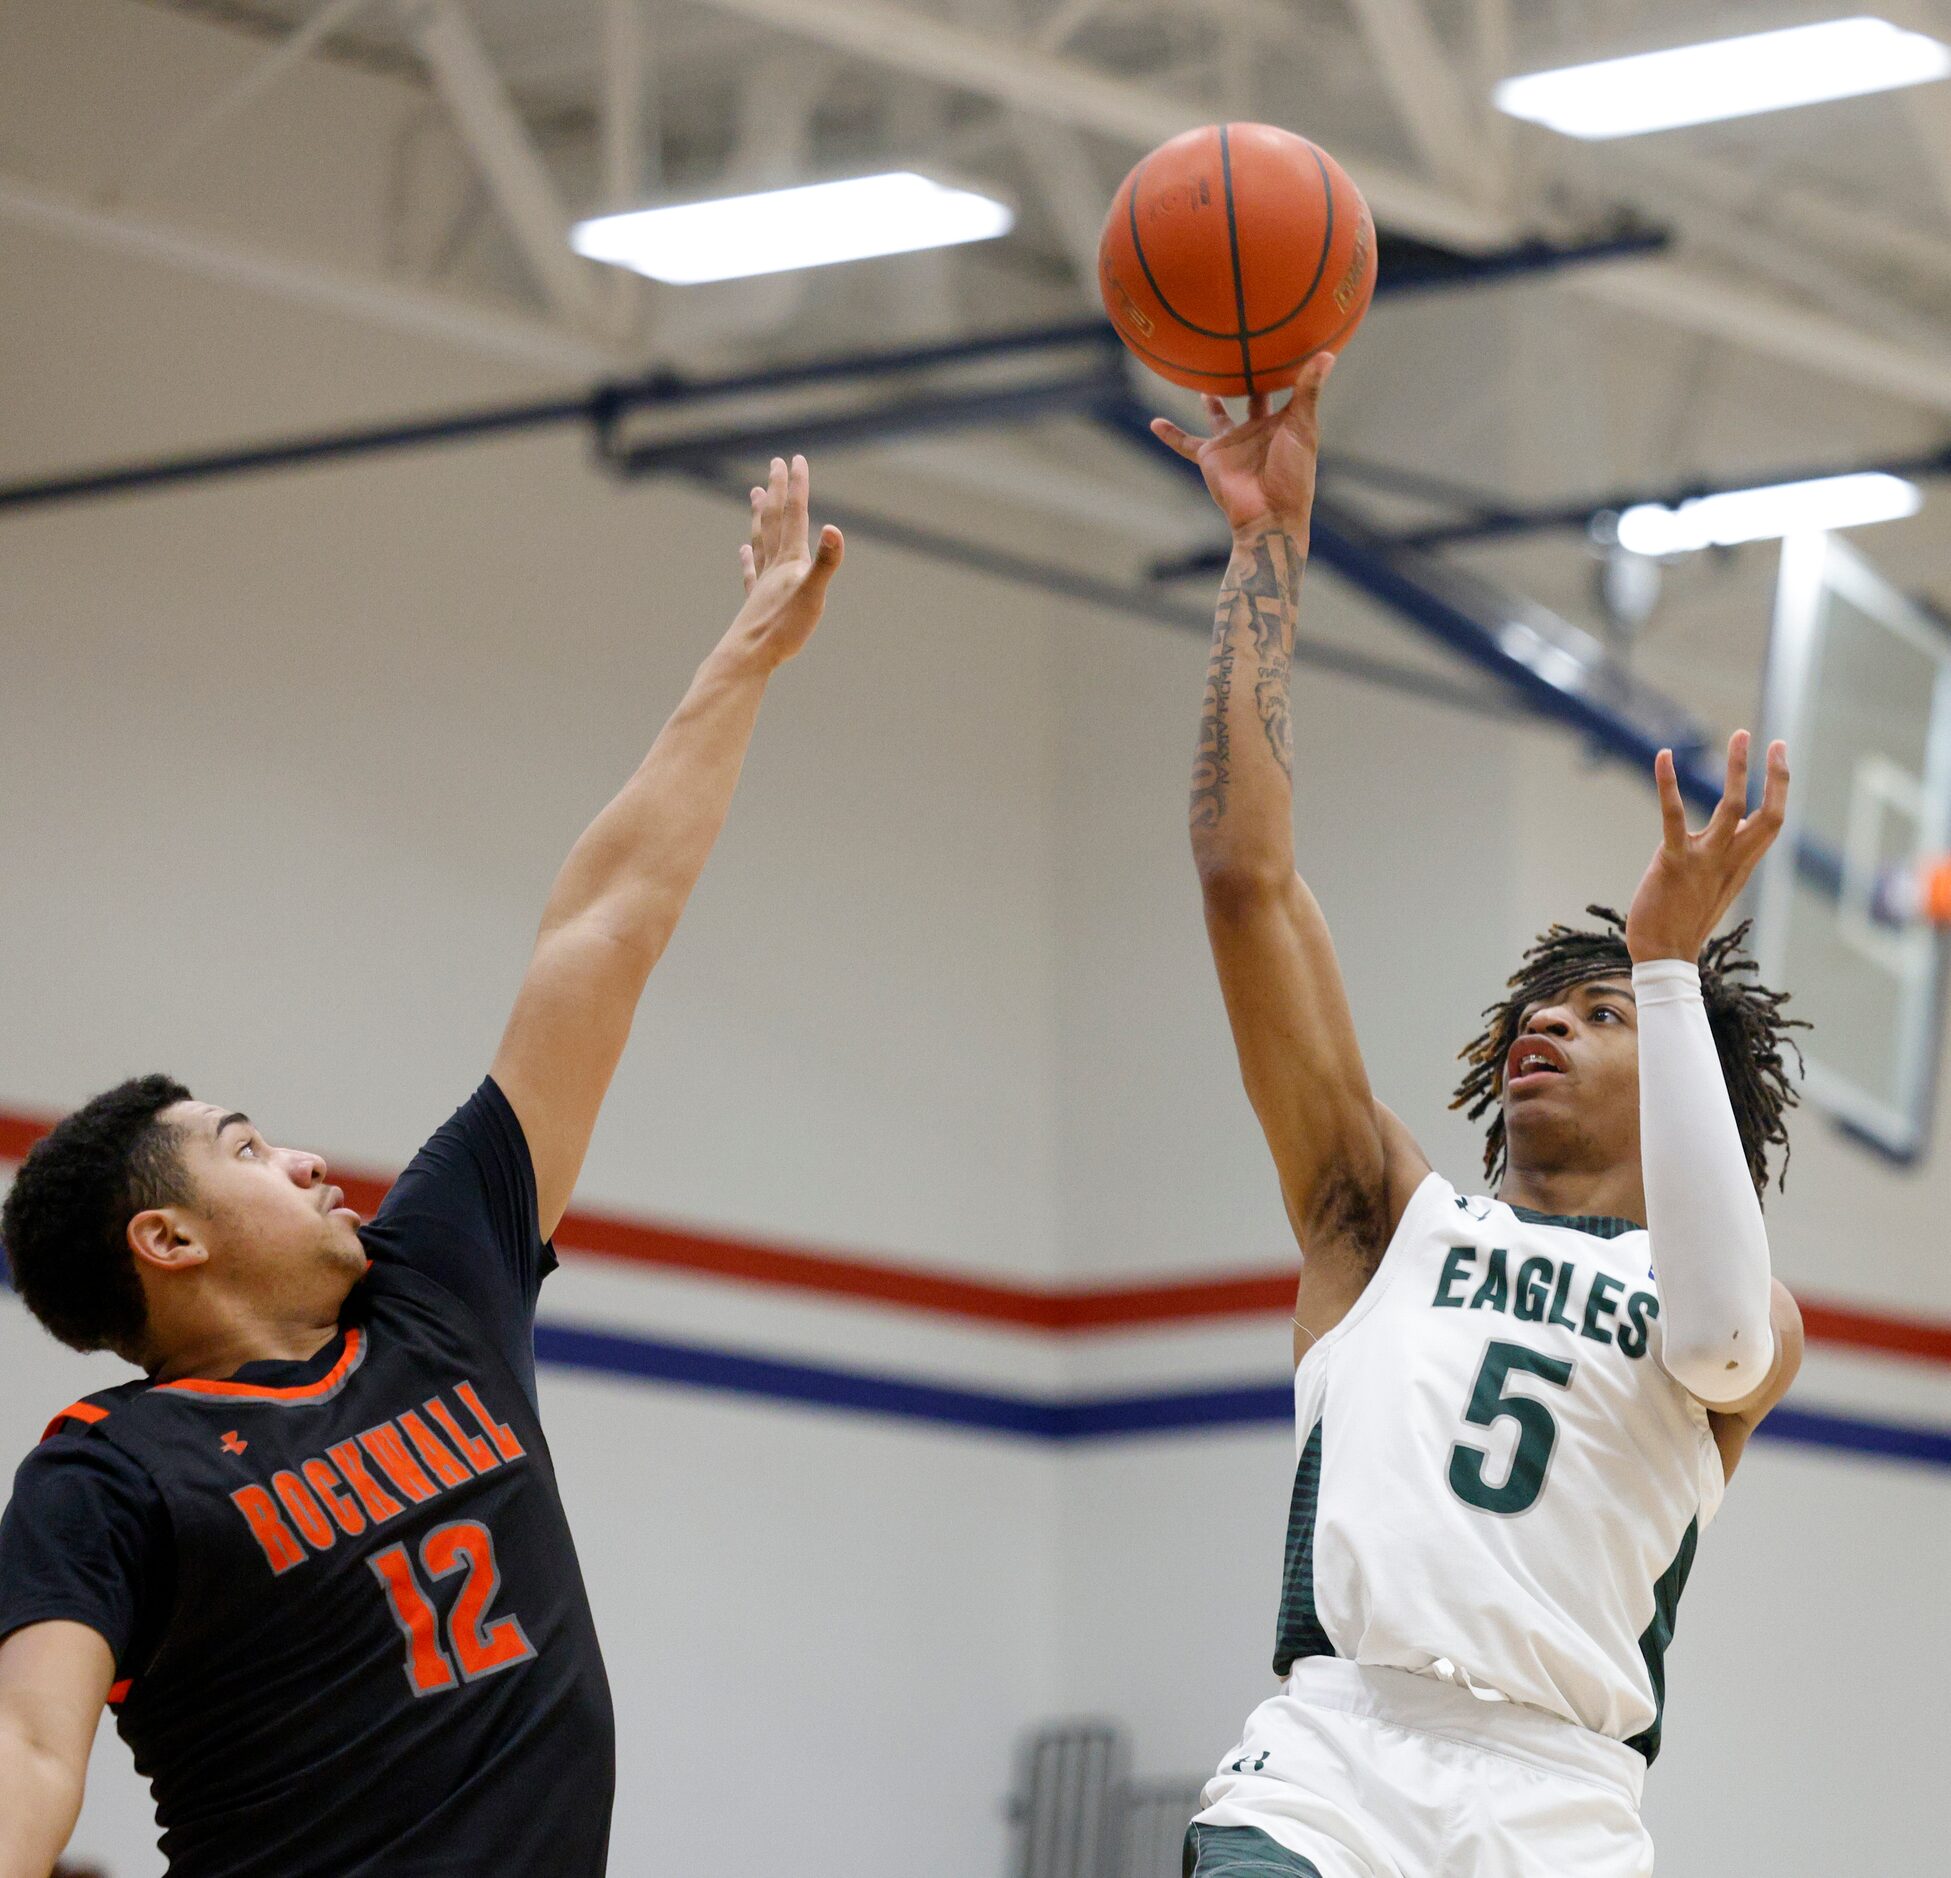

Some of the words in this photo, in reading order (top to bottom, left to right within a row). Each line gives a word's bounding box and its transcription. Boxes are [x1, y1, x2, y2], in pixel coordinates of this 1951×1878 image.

[1431, 1246, 1660, 1360] EAGLES
[229, 1379, 527, 1577] ROCKWALL
[1444, 1336, 1578, 1519] 5
[365, 1518, 538, 1698] 12
